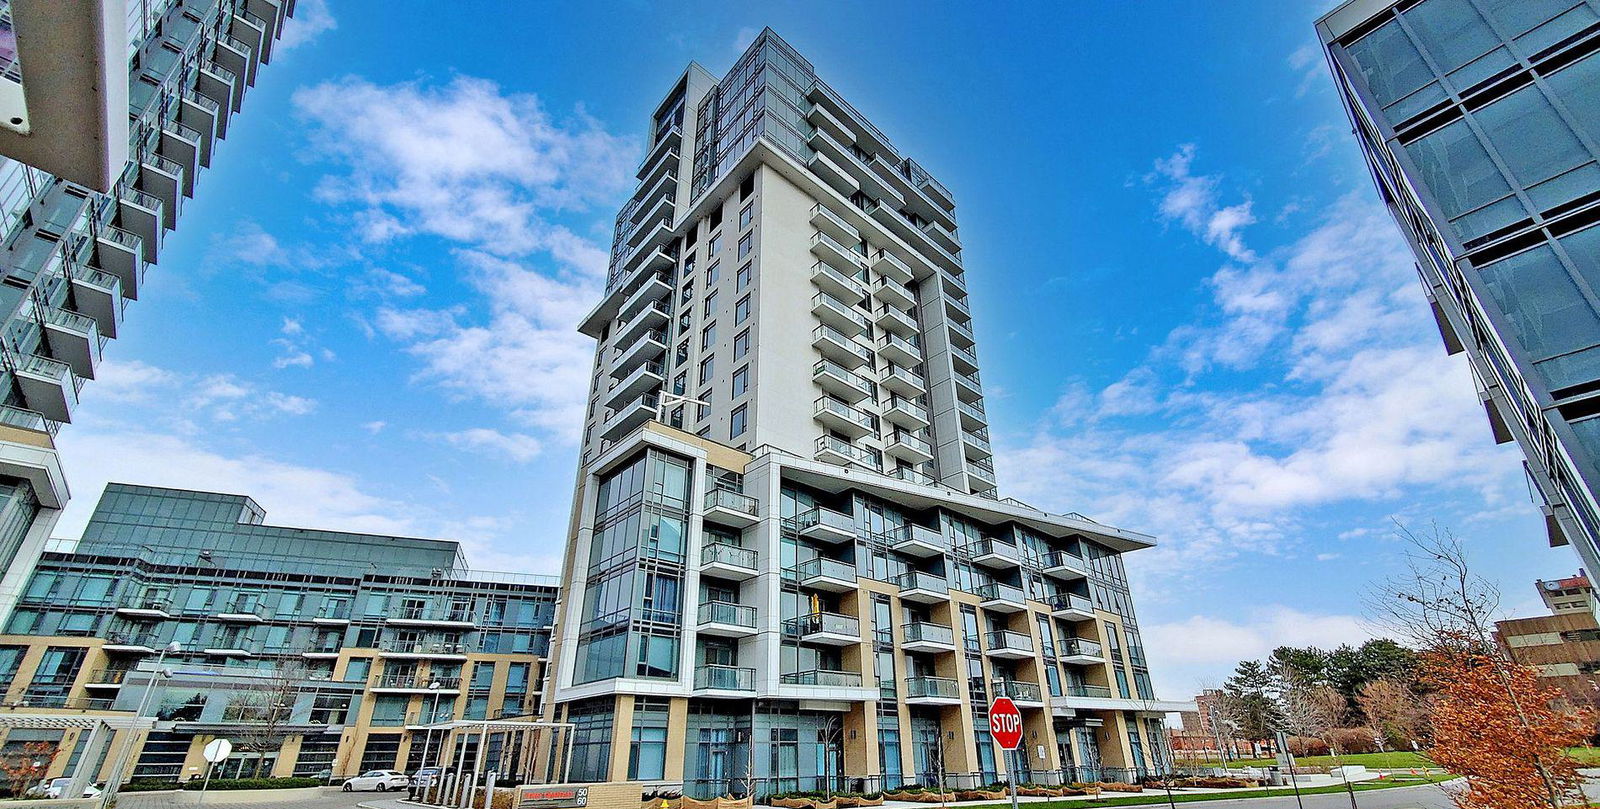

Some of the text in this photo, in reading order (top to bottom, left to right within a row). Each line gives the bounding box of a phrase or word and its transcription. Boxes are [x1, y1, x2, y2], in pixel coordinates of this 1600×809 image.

[992, 713, 1020, 733] STOP
[578, 788, 588, 796] 50
[577, 797, 587, 805] 60
